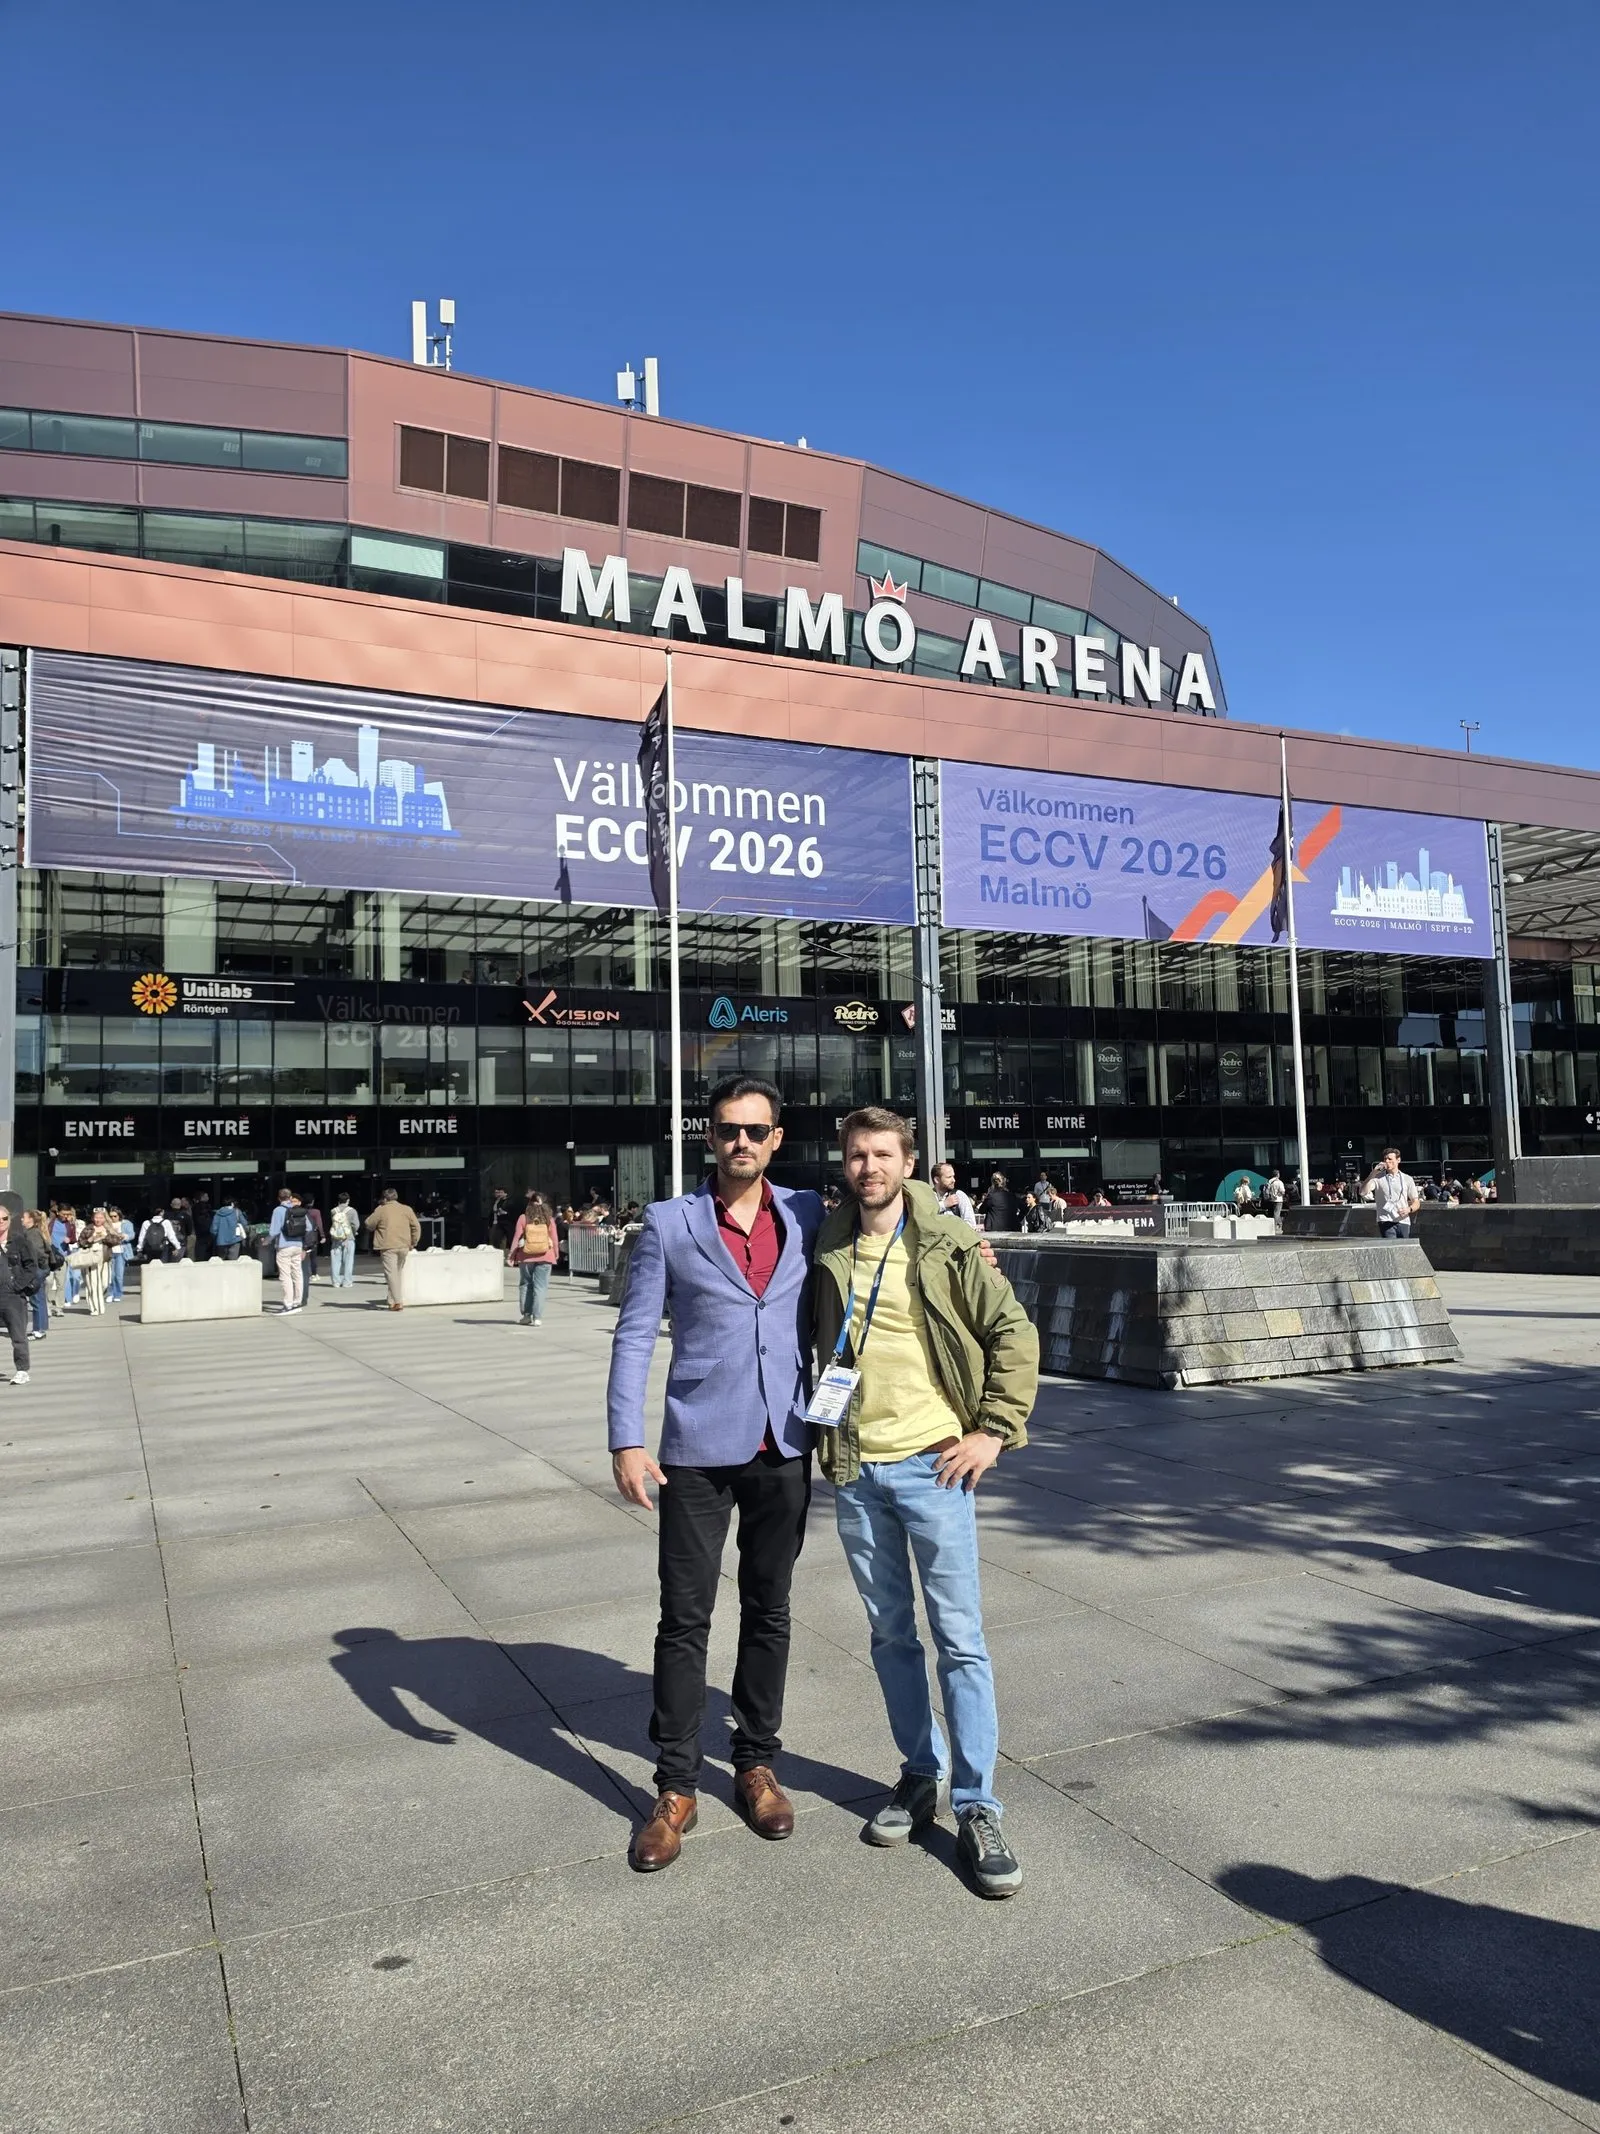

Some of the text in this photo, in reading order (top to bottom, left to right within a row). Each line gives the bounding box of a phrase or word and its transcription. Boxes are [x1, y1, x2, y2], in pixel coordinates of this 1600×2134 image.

[960, 617, 1216, 709] ARENA
[976, 787, 1135, 825] Välkommen
[708, 828, 824, 879] 2026
[979, 823, 1228, 881] ECCV 2026
[979, 875, 1092, 909] Malmö
[1334, 918, 1357, 926] ECCV
[1390, 920, 1422, 930] MALMÖ
[1431, 924, 1451, 932] SEPT
[183, 982, 252, 998] Unilabs
[183, 1004, 228, 1015] Röntgen
[741, 1005, 788, 1023] Aleris
[833, 1006, 879, 1021] Retro
[1097, 1053, 1123, 1063] Retro
[1219, 1057, 1243, 1067] Retro
[1101, 1087, 1121, 1095] Retro
[1223, 1089, 1242, 1097] Retro
[1347, 1140, 1353, 1149] 6
